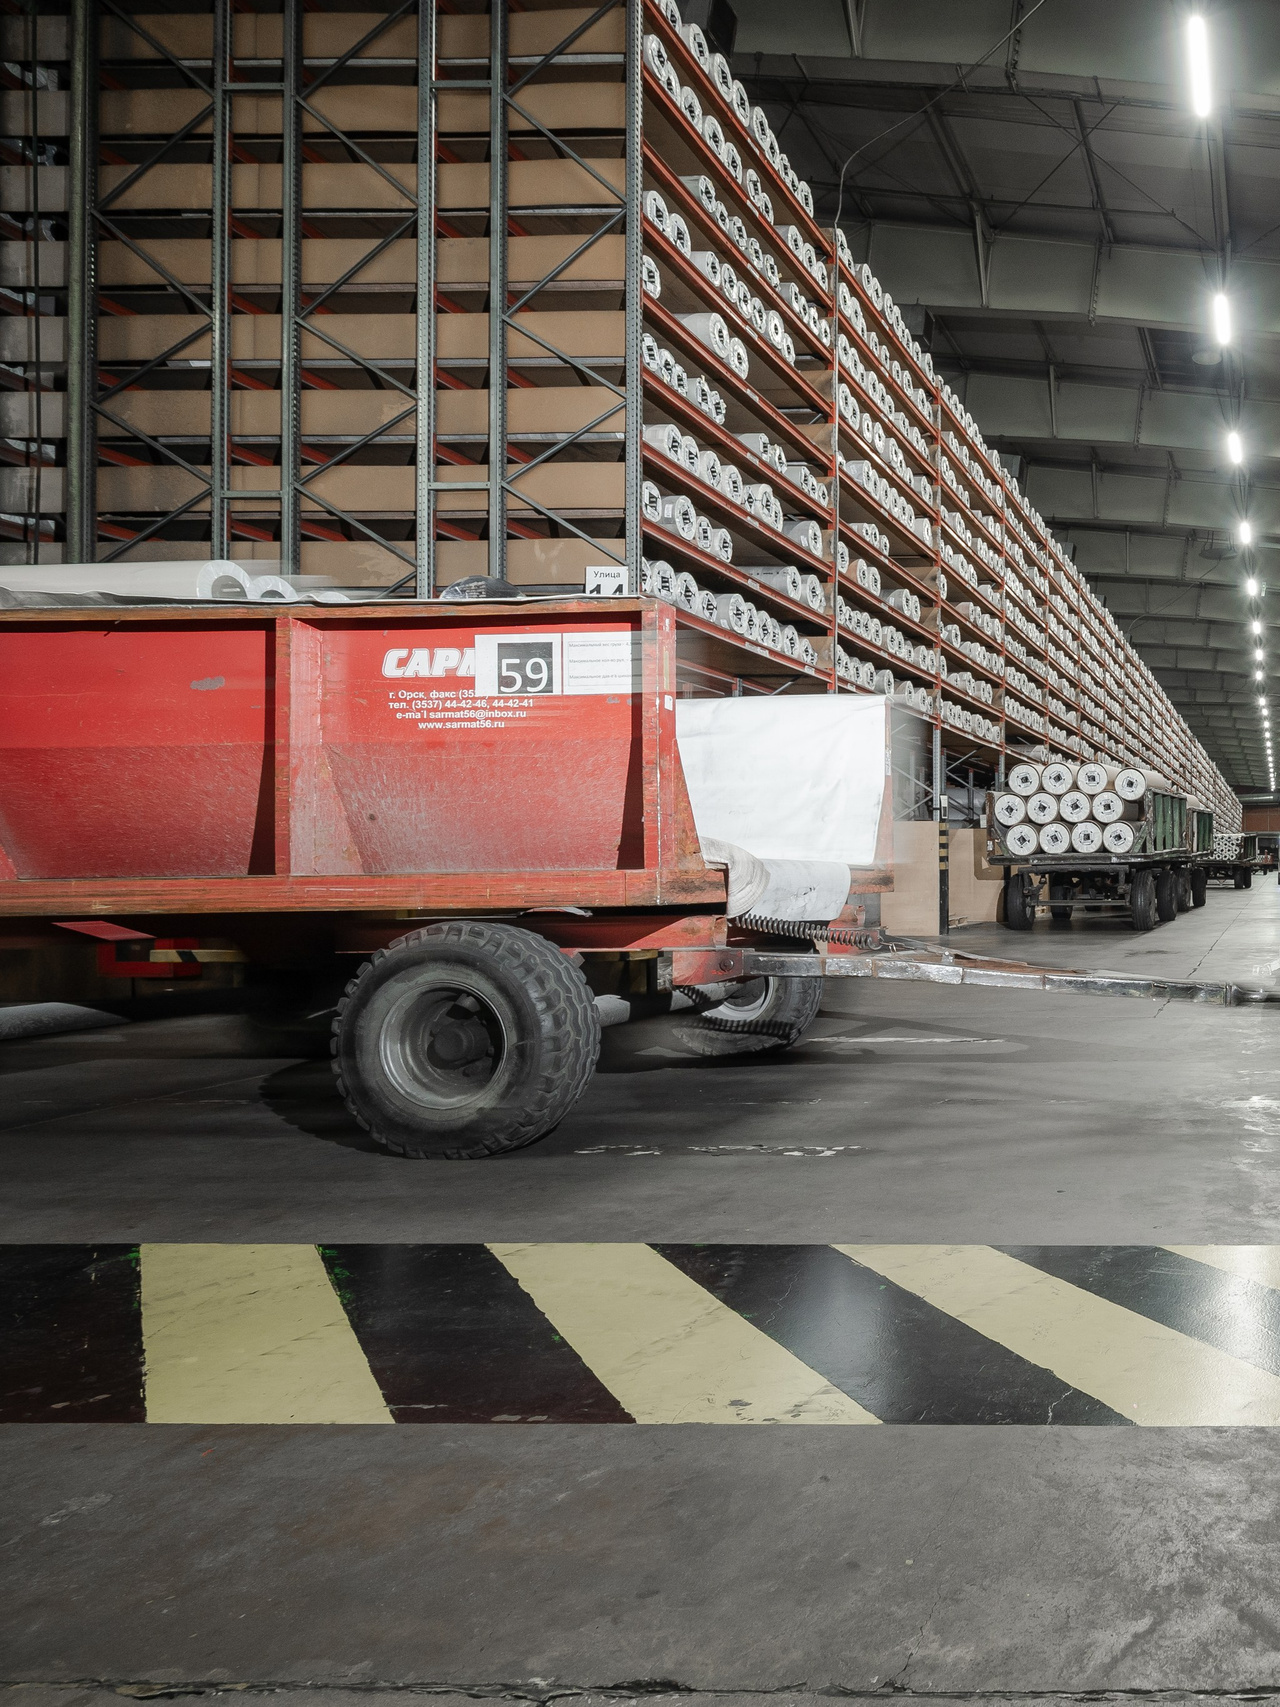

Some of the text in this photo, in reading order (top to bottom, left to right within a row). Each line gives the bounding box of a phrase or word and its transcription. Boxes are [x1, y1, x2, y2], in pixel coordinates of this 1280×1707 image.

[593, 570, 621, 579] Улица
[500, 656, 549, 693] 59
[389, 691, 396, 699] г.
[429, 690, 456, 700] факс
[412, 700, 443, 710] (3537)
[444, 699, 490, 709] 44-42-46,
[492, 699, 533, 708] 44-42-41
[429, 709, 527, 719] sarmat56@inbox.ru
[418, 719, 505, 730] www.sarmat56.ru
